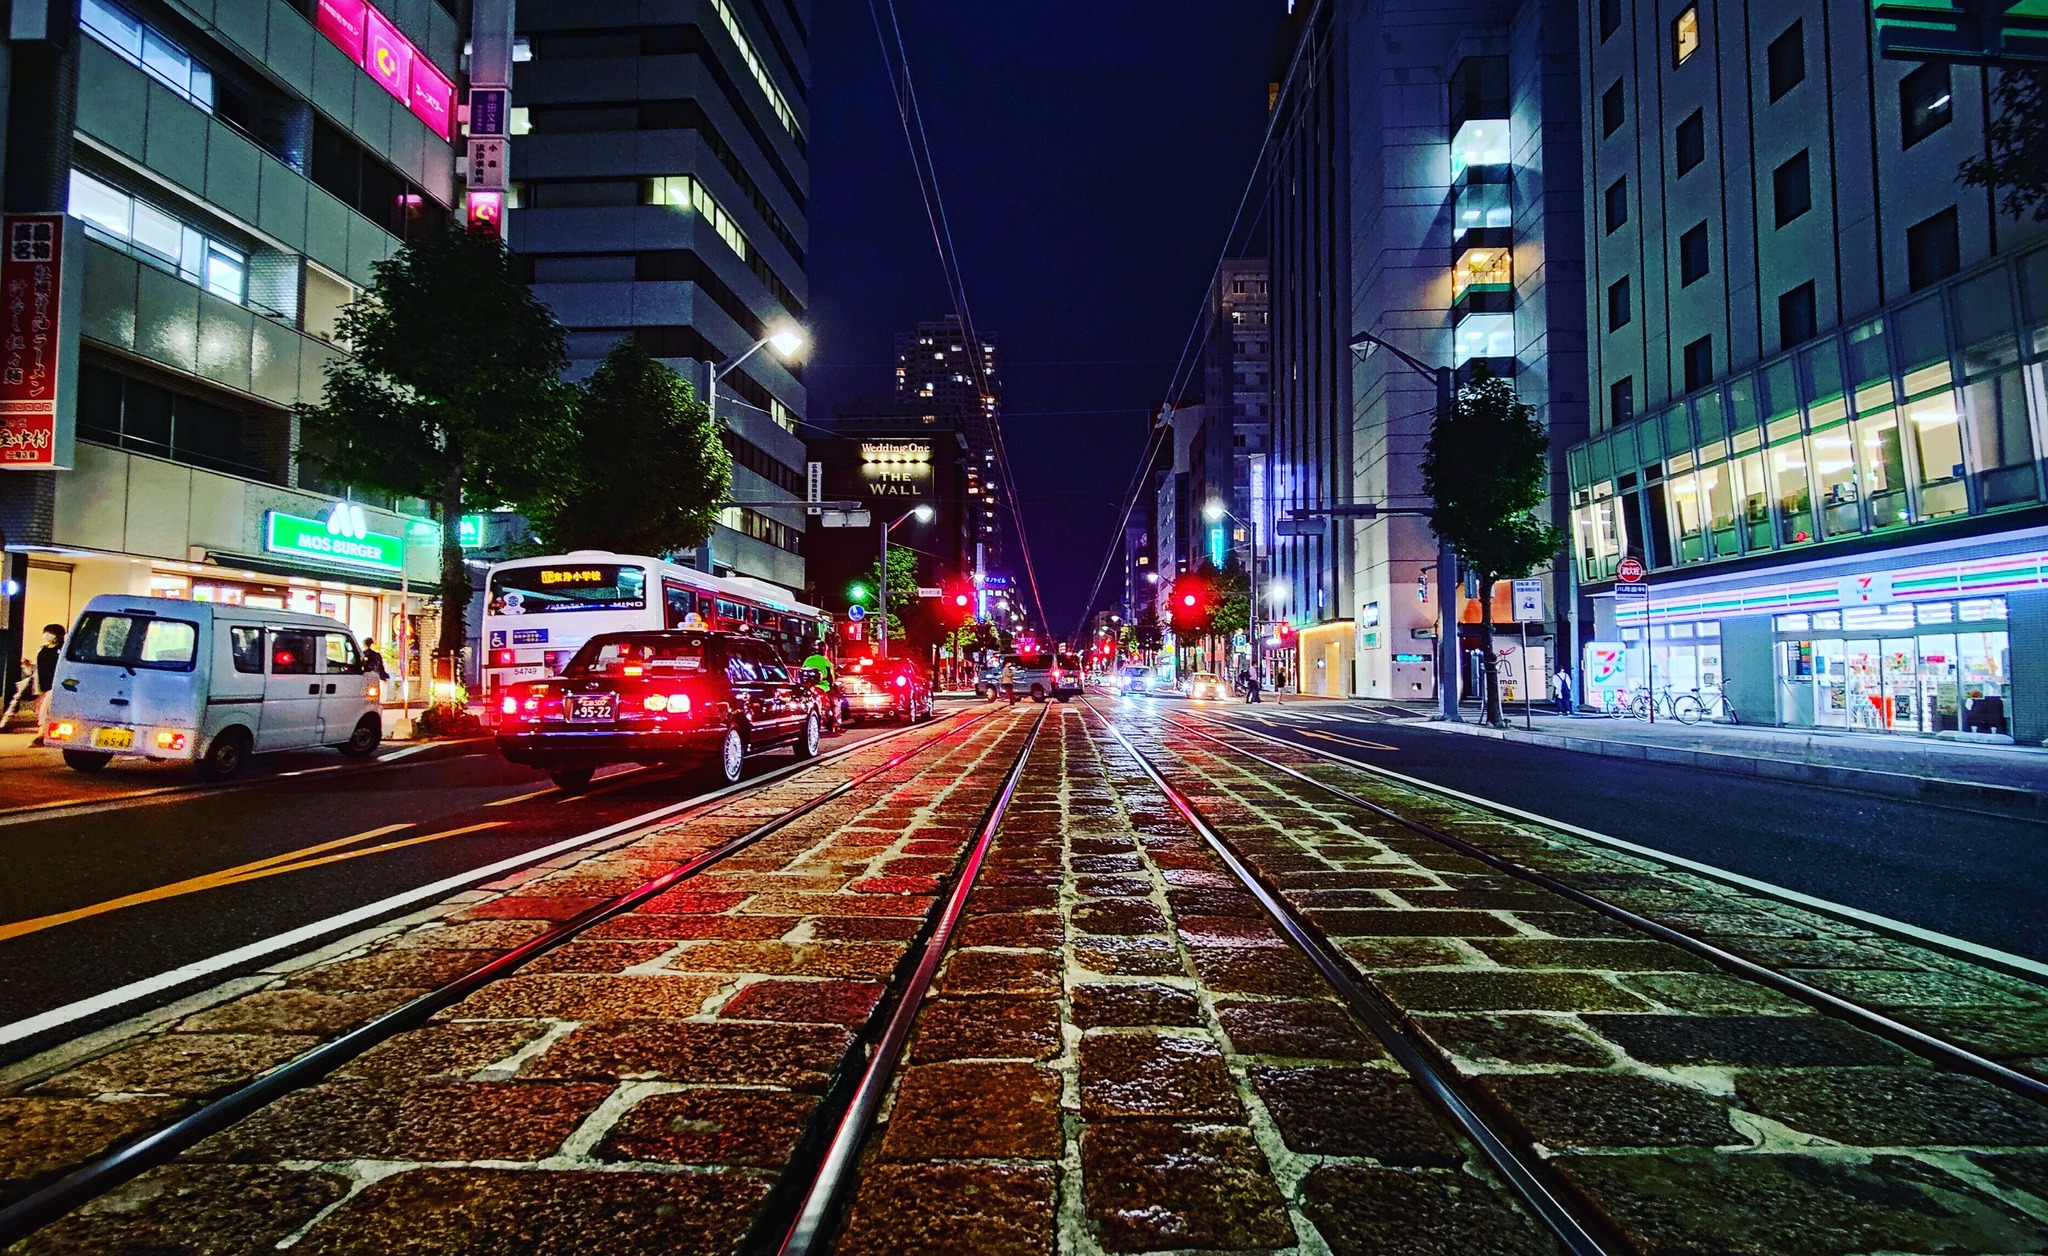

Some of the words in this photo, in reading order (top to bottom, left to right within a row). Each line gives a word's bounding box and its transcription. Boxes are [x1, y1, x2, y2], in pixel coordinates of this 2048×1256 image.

[861, 443, 908, 455] Wedding
[908, 443, 931, 453] One
[880, 471, 912, 482] THE
[869, 483, 922, 495] WALL
[297, 532, 331, 553] MOS
[332, 539, 382, 561] BURGER
[1621, 566, 1641, 576] 消火栓
[514, 668, 537, 676] 54749
[580, 706, 612, 718] 95-22
